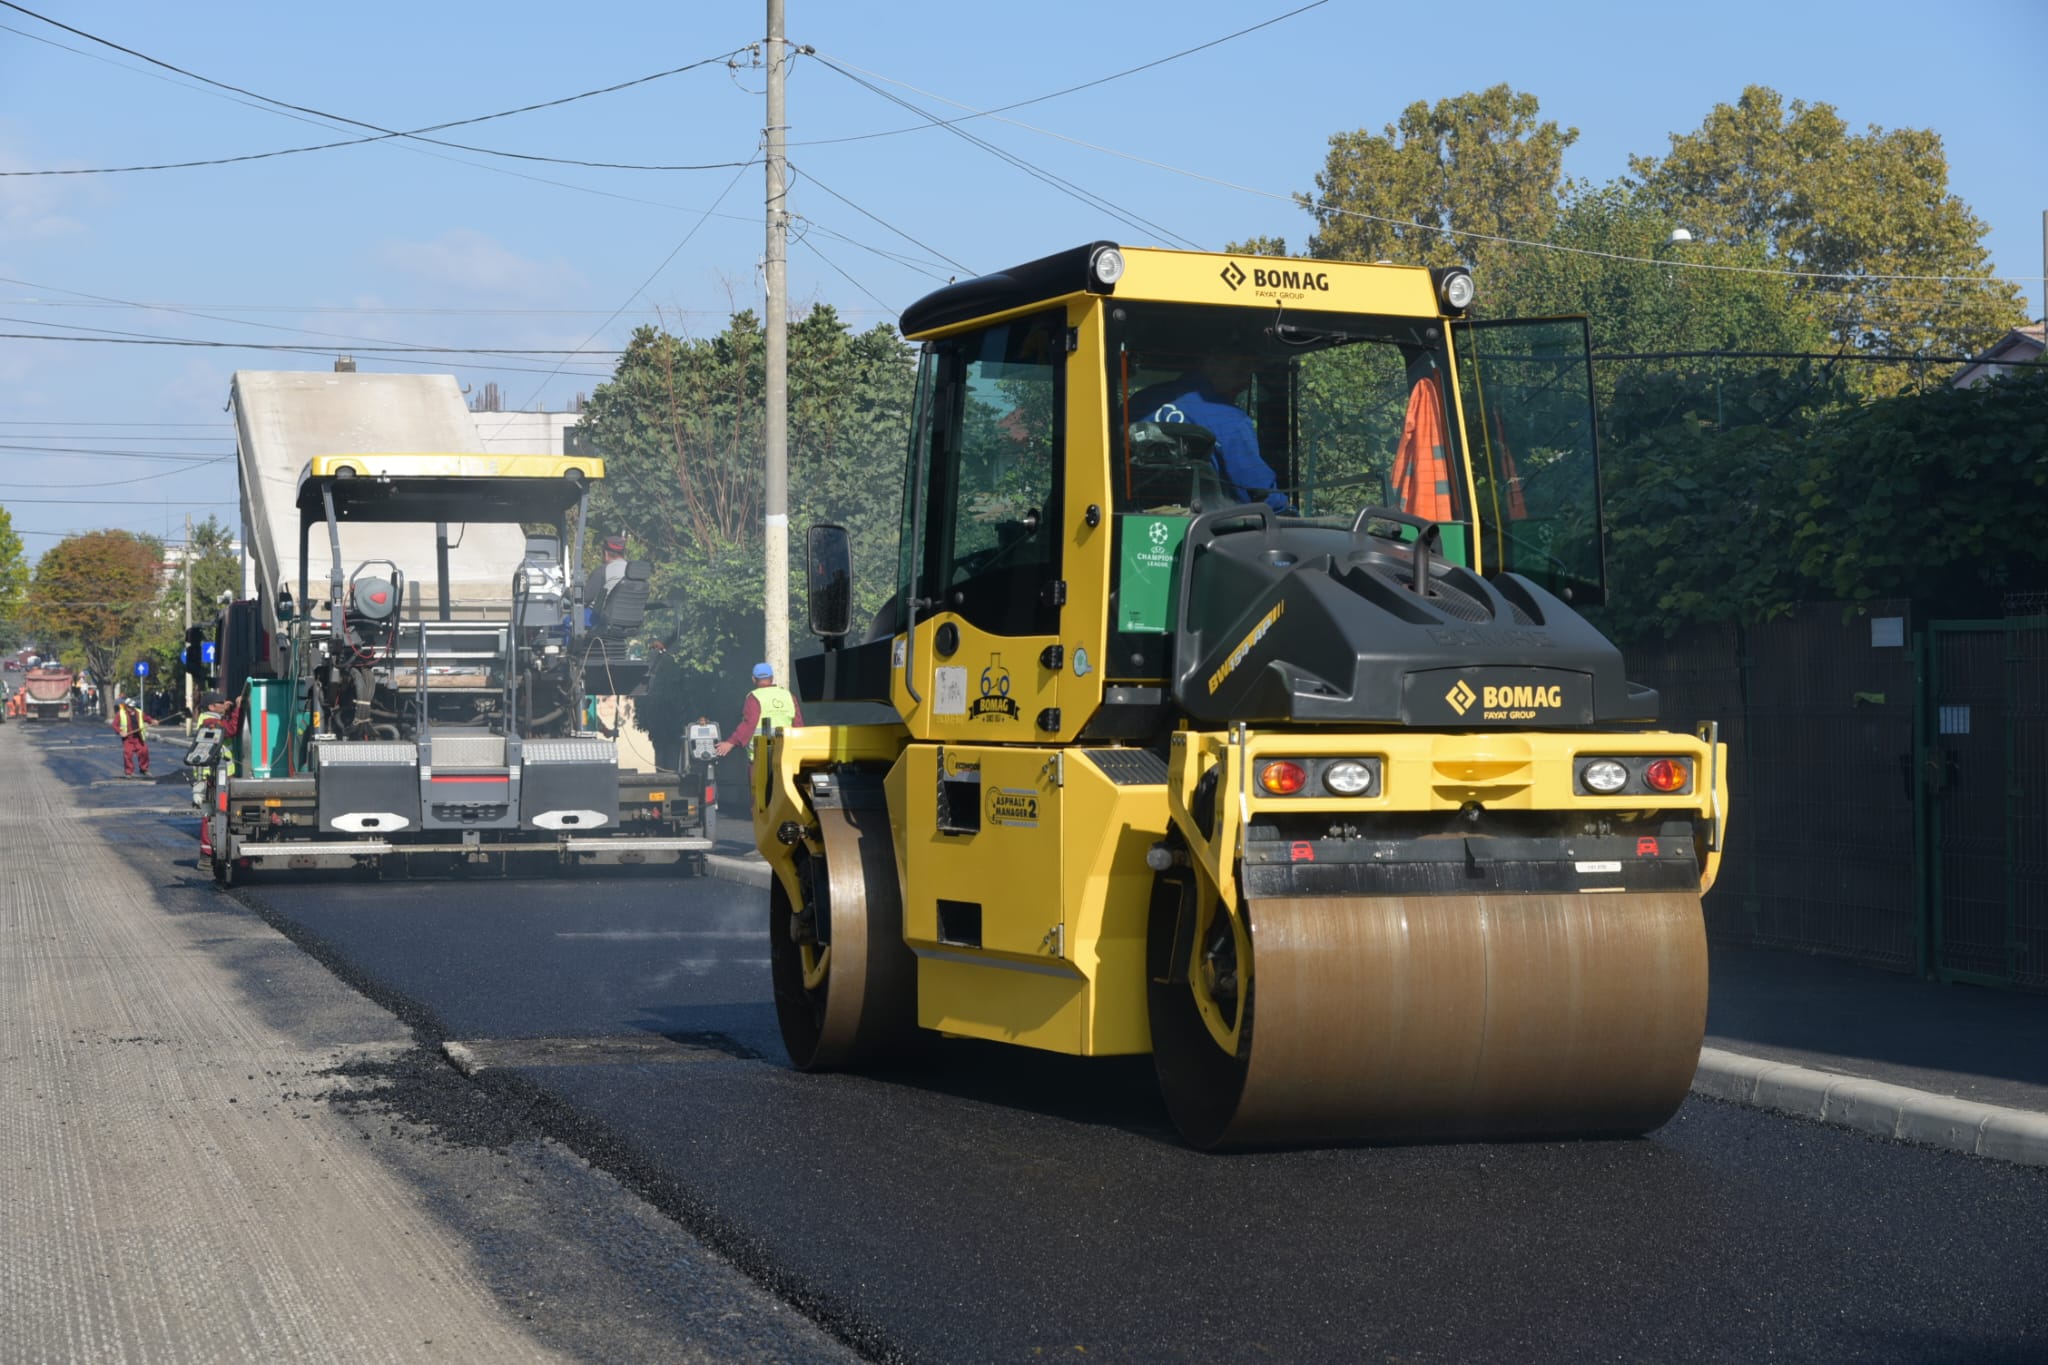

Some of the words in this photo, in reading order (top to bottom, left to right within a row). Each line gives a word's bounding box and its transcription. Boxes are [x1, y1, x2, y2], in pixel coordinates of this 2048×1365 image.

[1254, 268, 1329, 291] BOMAG
[1255, 290, 1277, 298] FAYAT
[1280, 292, 1304, 300] GROUP
[1483, 685, 1561, 708] BOMAG
[979, 698, 1009, 712] BOMAG
[1484, 711, 1508, 719] FAYAT
[1509, 711, 1536, 719] GROUP
[996, 796, 1025, 806] ASPHALT
[995, 807, 1027, 818] MANAGER
[1028, 799, 1037, 818] 2
